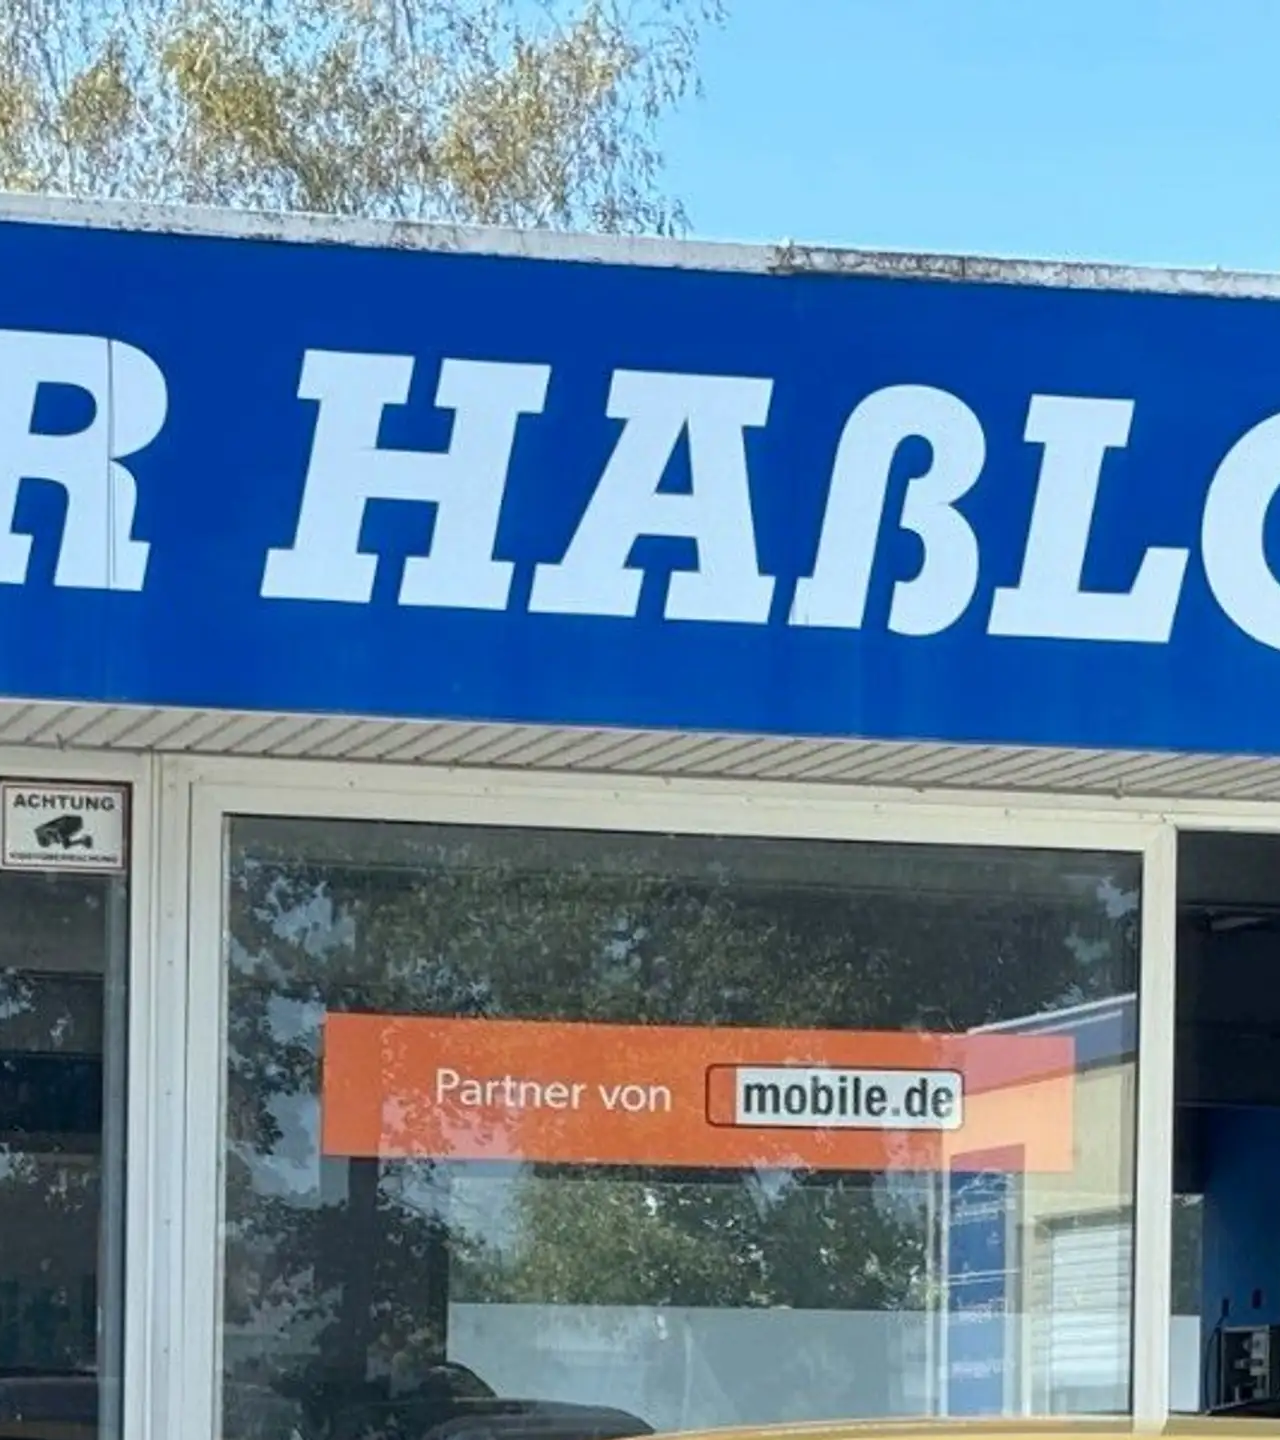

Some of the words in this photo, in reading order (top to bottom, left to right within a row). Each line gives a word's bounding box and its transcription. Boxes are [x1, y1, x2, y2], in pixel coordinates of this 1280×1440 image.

[13, 792, 116, 811] ACHTUNG
[435, 1068, 585, 1111] Partner
[598, 1082, 671, 1112] von
[742, 1075, 956, 1119] mobile.de
